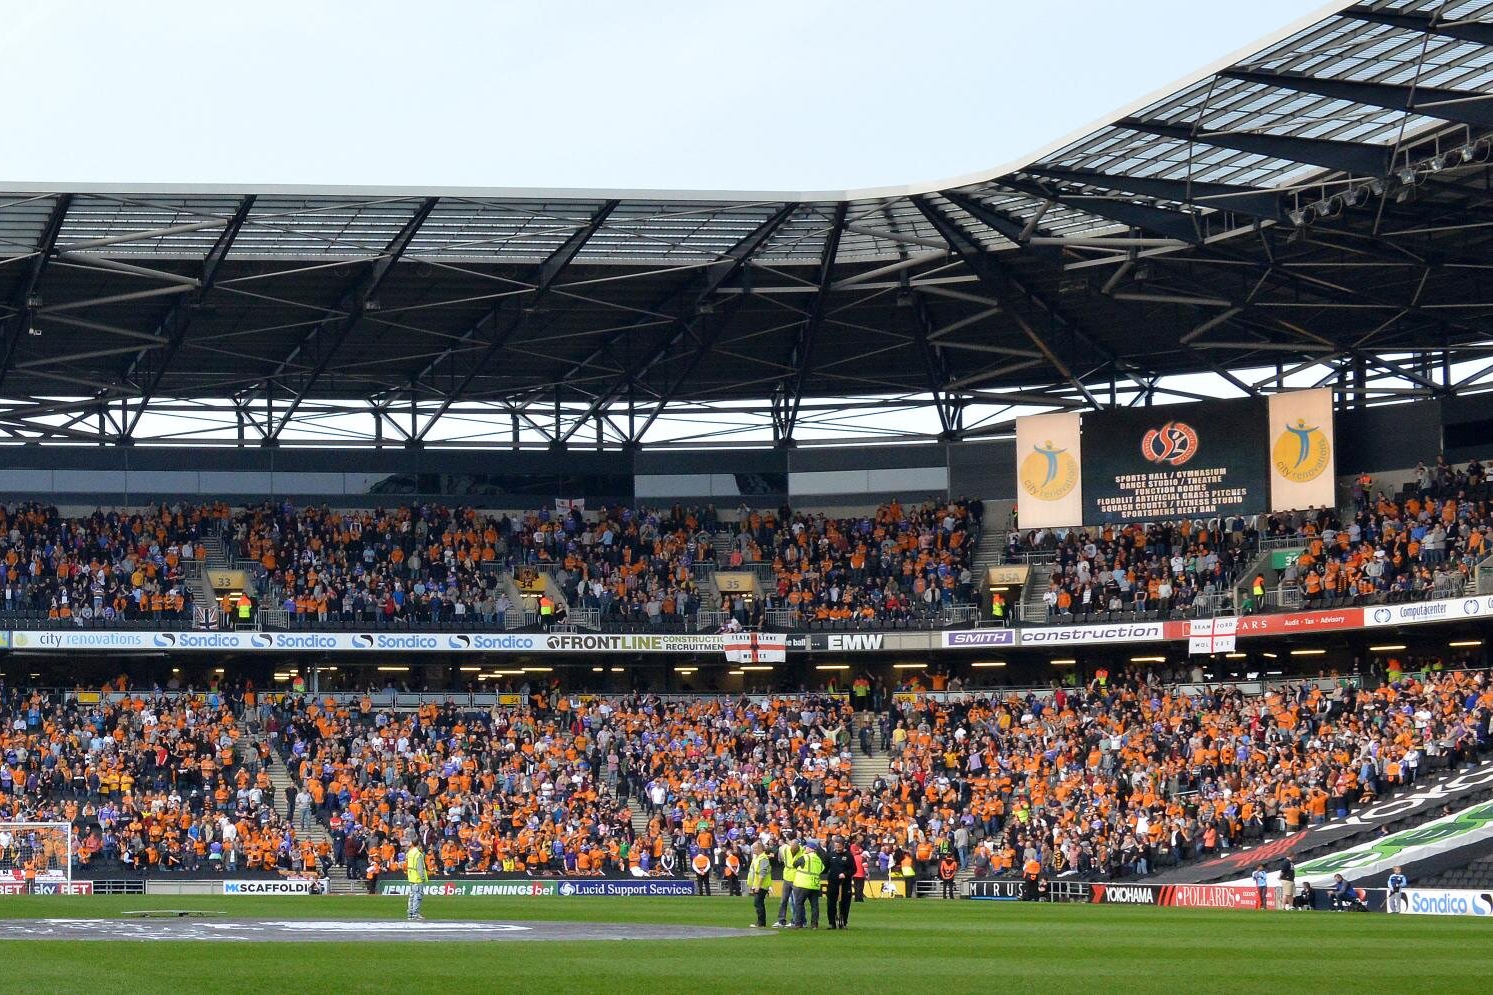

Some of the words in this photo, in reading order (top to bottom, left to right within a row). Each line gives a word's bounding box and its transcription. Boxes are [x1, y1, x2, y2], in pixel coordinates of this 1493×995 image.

[1115, 473, 1147, 483] SPORTS
[1148, 472, 1168, 481] HALL
[1176, 467, 1227, 478] GYMNASIUM
[1119, 481, 1147, 490] DANCE
[1148, 479, 1179, 488] STUDIO
[1187, 475, 1223, 484] THEATRE
[1096, 496, 1134, 506] FLOODLIT
[1135, 492, 1181, 503] ARTIFICIAL
[1182, 490, 1210, 500] GRASS
[1211, 488, 1247, 497] PITCHES
[1134, 486, 1175, 496] FUNCTION
[1177, 484, 1207, 493] ROOMS
[1101, 503, 1134, 513] SQUASH
[1135, 501, 1168, 511] COURTS
[1176, 498, 1210, 508] FITNESS
[1211, 496, 1243, 505] STUDIO
[1177, 506, 1197, 515] REST
[1199, 505, 1217, 513] BAR
[218, 577, 231, 587] 33
[726, 580, 740, 590] 35
[999, 572, 1020, 583] 35A
[1399, 602, 1447, 620] Computacenter
[1284, 618, 1299, 626] Audit
[1320, 615, 1345, 625] Advisory
[39, 632, 62, 648] city
[66, 632, 142, 646] renovations
[179, 634, 240, 648] Sondico
[276, 634, 337, 649] Sondico
[377, 635, 437, 649] Sondico
[474, 635, 533, 649] Sondico
[827, 634, 883, 650] EMW
[955, 632, 1006, 644] SMITH
[1021, 625, 1159, 643] construction
[560, 635, 663, 650] FRONTLINE
[665, 643, 724, 651] RECRUITMEN
[34, 882, 55, 895] sky
[575, 883, 605, 895] Lucid
[607, 884, 653, 897] Support
[653, 883, 693, 896] Services
[1105, 886, 1154, 904] YOKOHAMA
[1182, 886, 1236, 908] POLLARDS
[1412, 891, 1468, 914] Sondico
